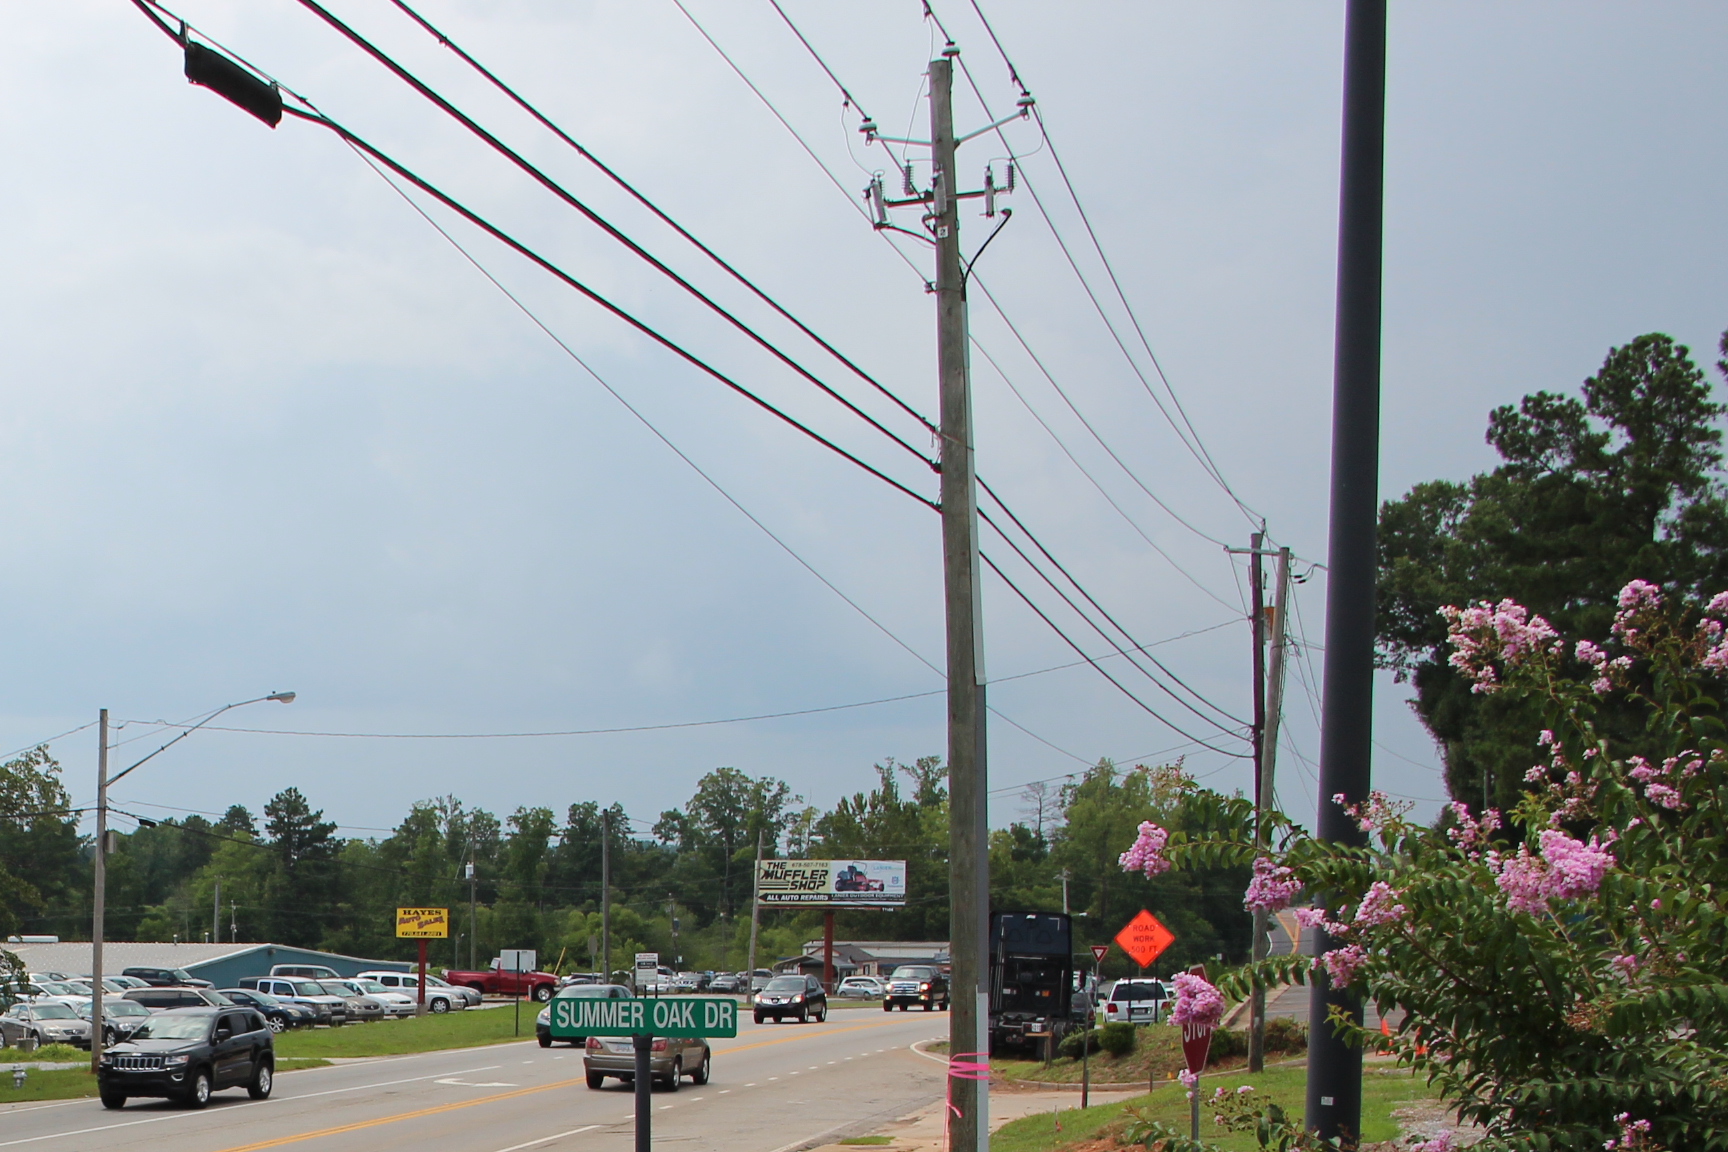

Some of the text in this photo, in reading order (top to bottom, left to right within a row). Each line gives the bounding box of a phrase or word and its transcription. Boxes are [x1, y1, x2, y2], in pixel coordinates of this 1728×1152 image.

[767, 861, 787, 870] THE
[761, 869, 829, 880] MUFFLER
[789, 880, 826, 890] SHOP
[1132, 924, 1156, 932] ROAD
[1131, 945, 1146, 953] 500
[555, 1000, 733, 1028] SUMMER OAK DR
